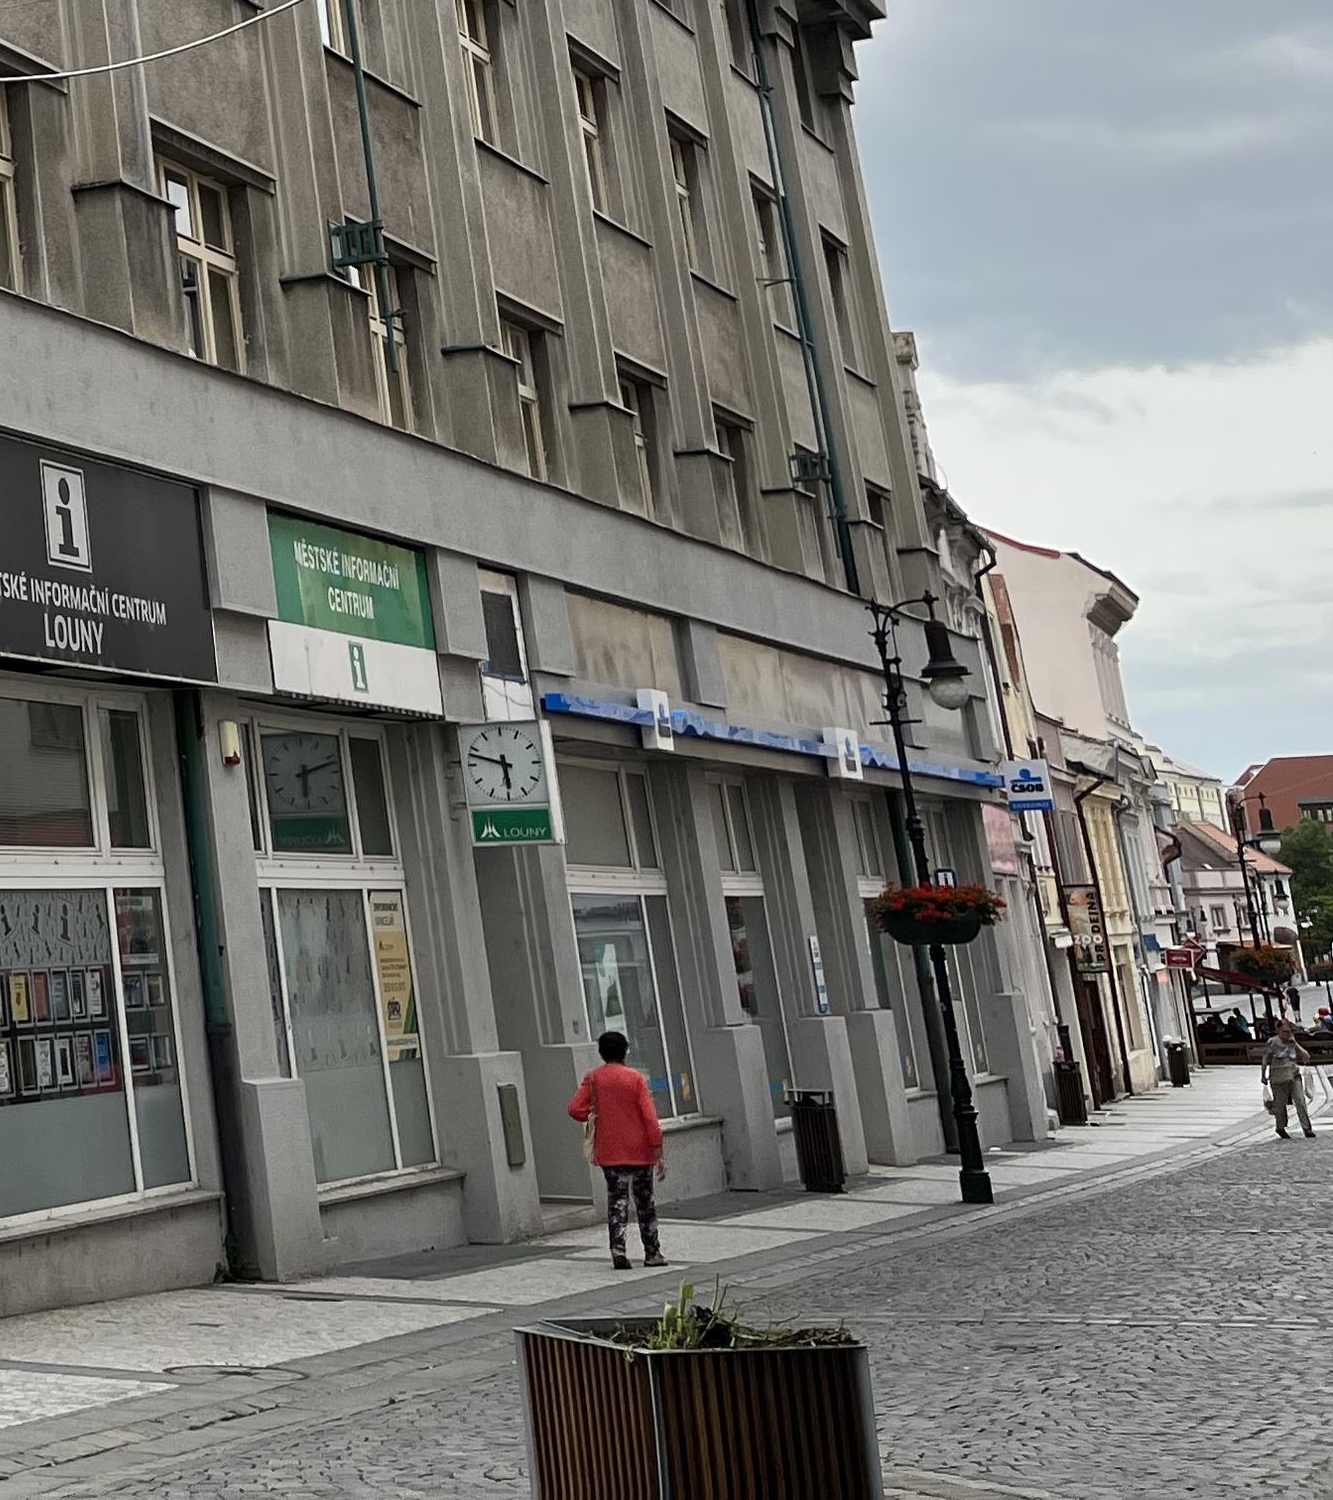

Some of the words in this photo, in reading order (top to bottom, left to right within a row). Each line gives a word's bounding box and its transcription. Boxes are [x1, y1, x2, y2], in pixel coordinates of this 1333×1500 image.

[293, 538, 340, 576] MĚSTSKÉ
[341, 555, 400, 590] INFORMAČNÍ
[30, 578, 110, 616] INFORMAČNÍ
[112, 593, 167, 626] CENTRUM
[328, 586, 374, 620] CENTRUM
[44, 612, 103, 655] LOUNY
[503, 826, 547, 838] LOUNY
